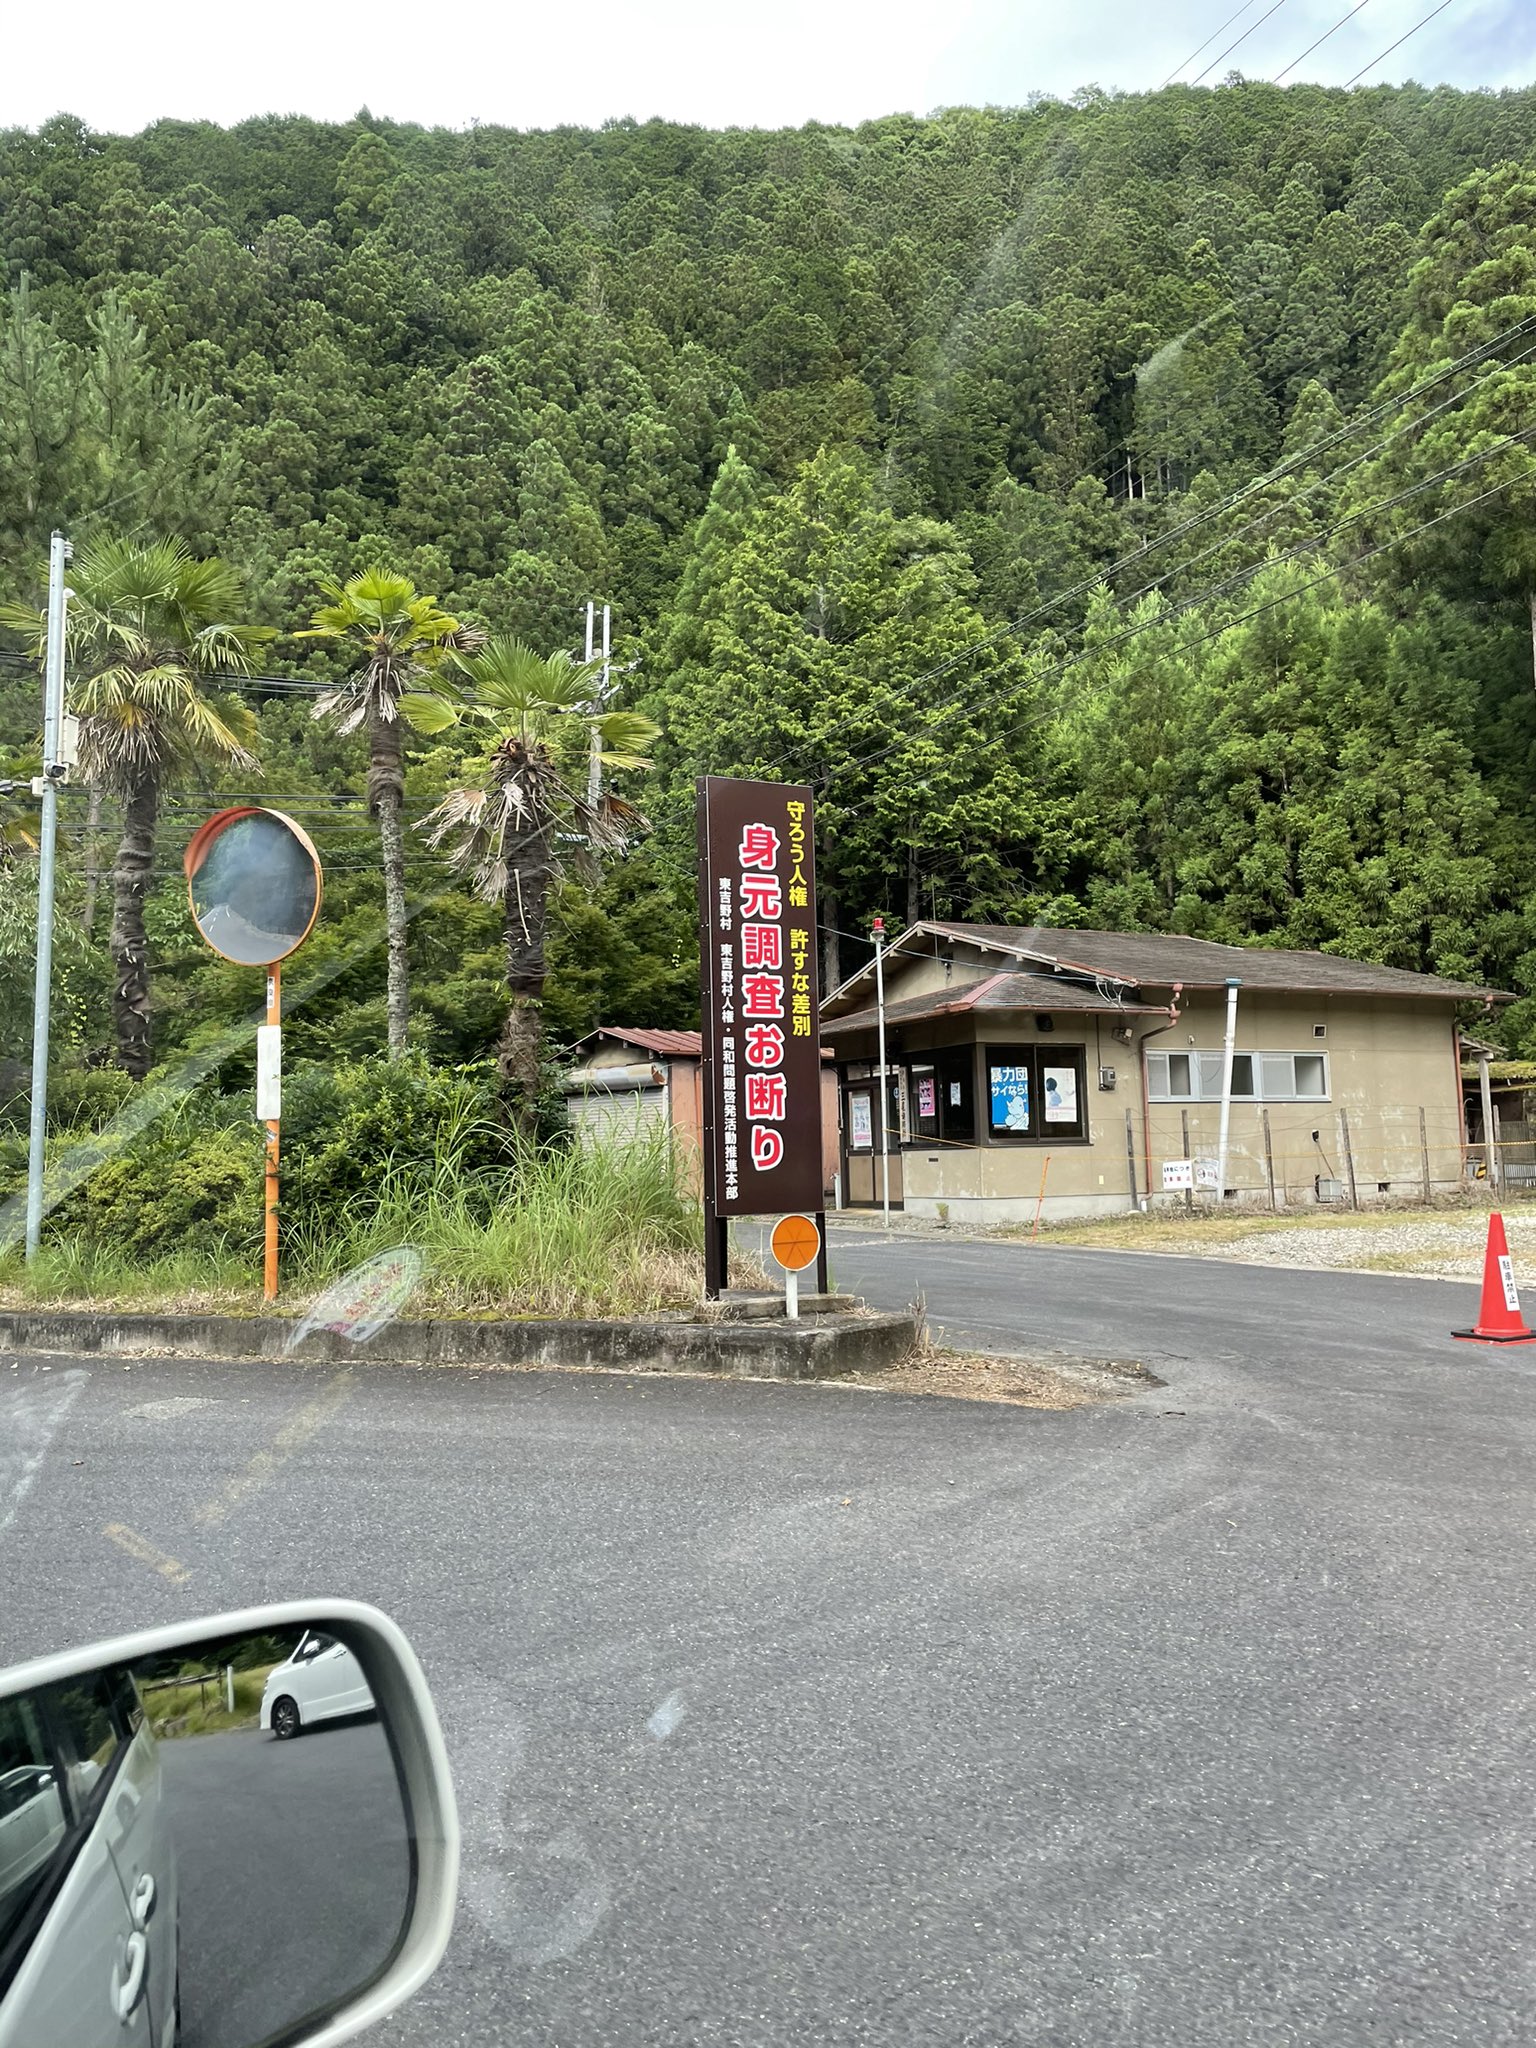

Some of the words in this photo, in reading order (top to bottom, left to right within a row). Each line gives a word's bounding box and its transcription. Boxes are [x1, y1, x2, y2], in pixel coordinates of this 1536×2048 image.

[718, 877, 733, 931] 東吉野村
[786, 800, 809, 907] 守ろう人権
[739, 823, 786, 1171] 身元調査お断り
[789, 928, 811, 1037] 許すな差別
[990, 1066, 1028, 1082] 暴力団
